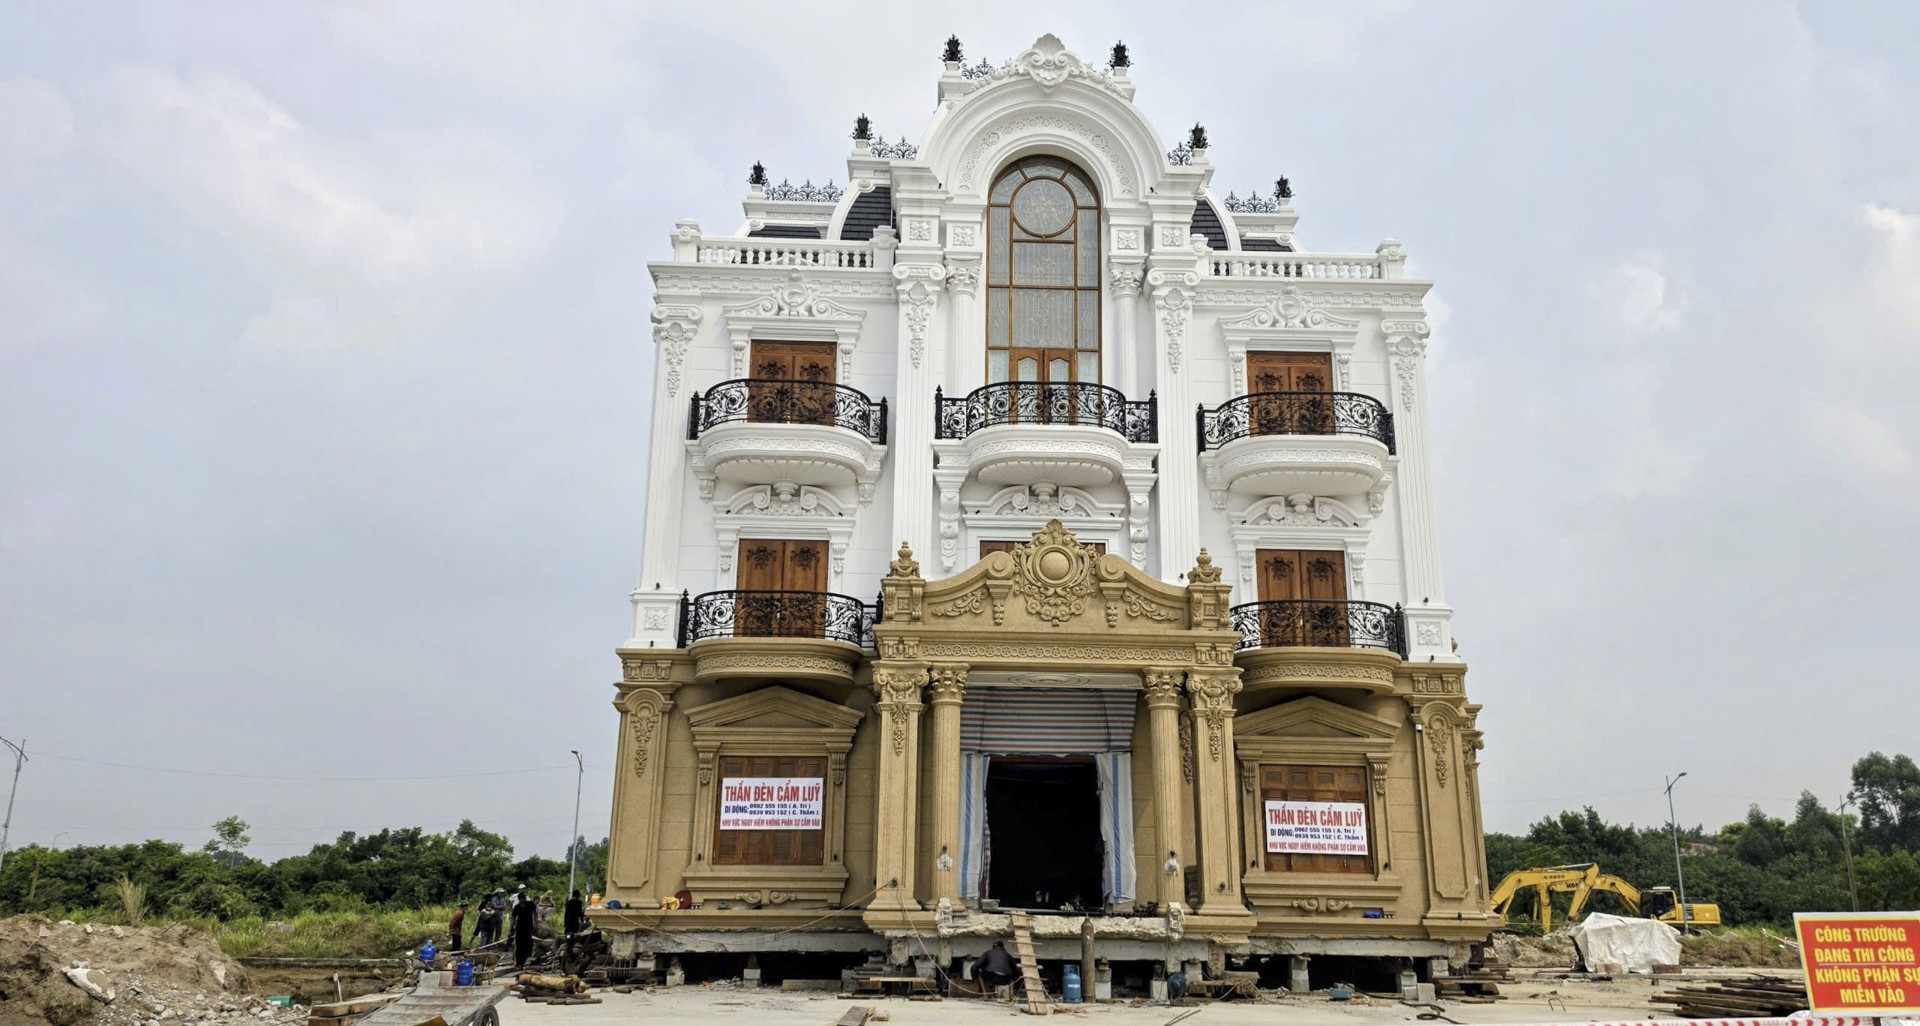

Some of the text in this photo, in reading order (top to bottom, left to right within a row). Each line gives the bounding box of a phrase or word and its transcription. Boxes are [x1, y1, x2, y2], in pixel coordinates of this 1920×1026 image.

[754, 782, 774, 802] ĐÈN
[777, 780, 800, 802] CẨM
[802, 783, 820, 802] LUỸ
[725, 805, 731, 813] DI
[1297, 806, 1317, 826] ĐÈN
[1320, 805, 1342, 826] CẨM
[1345, 808, 1363, 827] LUỸ
[1814, 924, 1907, 943] CÔNG TRƯỜNG
[1814, 945, 1915, 962] ĐANG THI CÔNG
[1815, 965, 1861, 983] KHÔNG
[1863, 965, 1901, 985] PHẬN
[1840, 983, 1905, 1003] MIỄN VÀO
